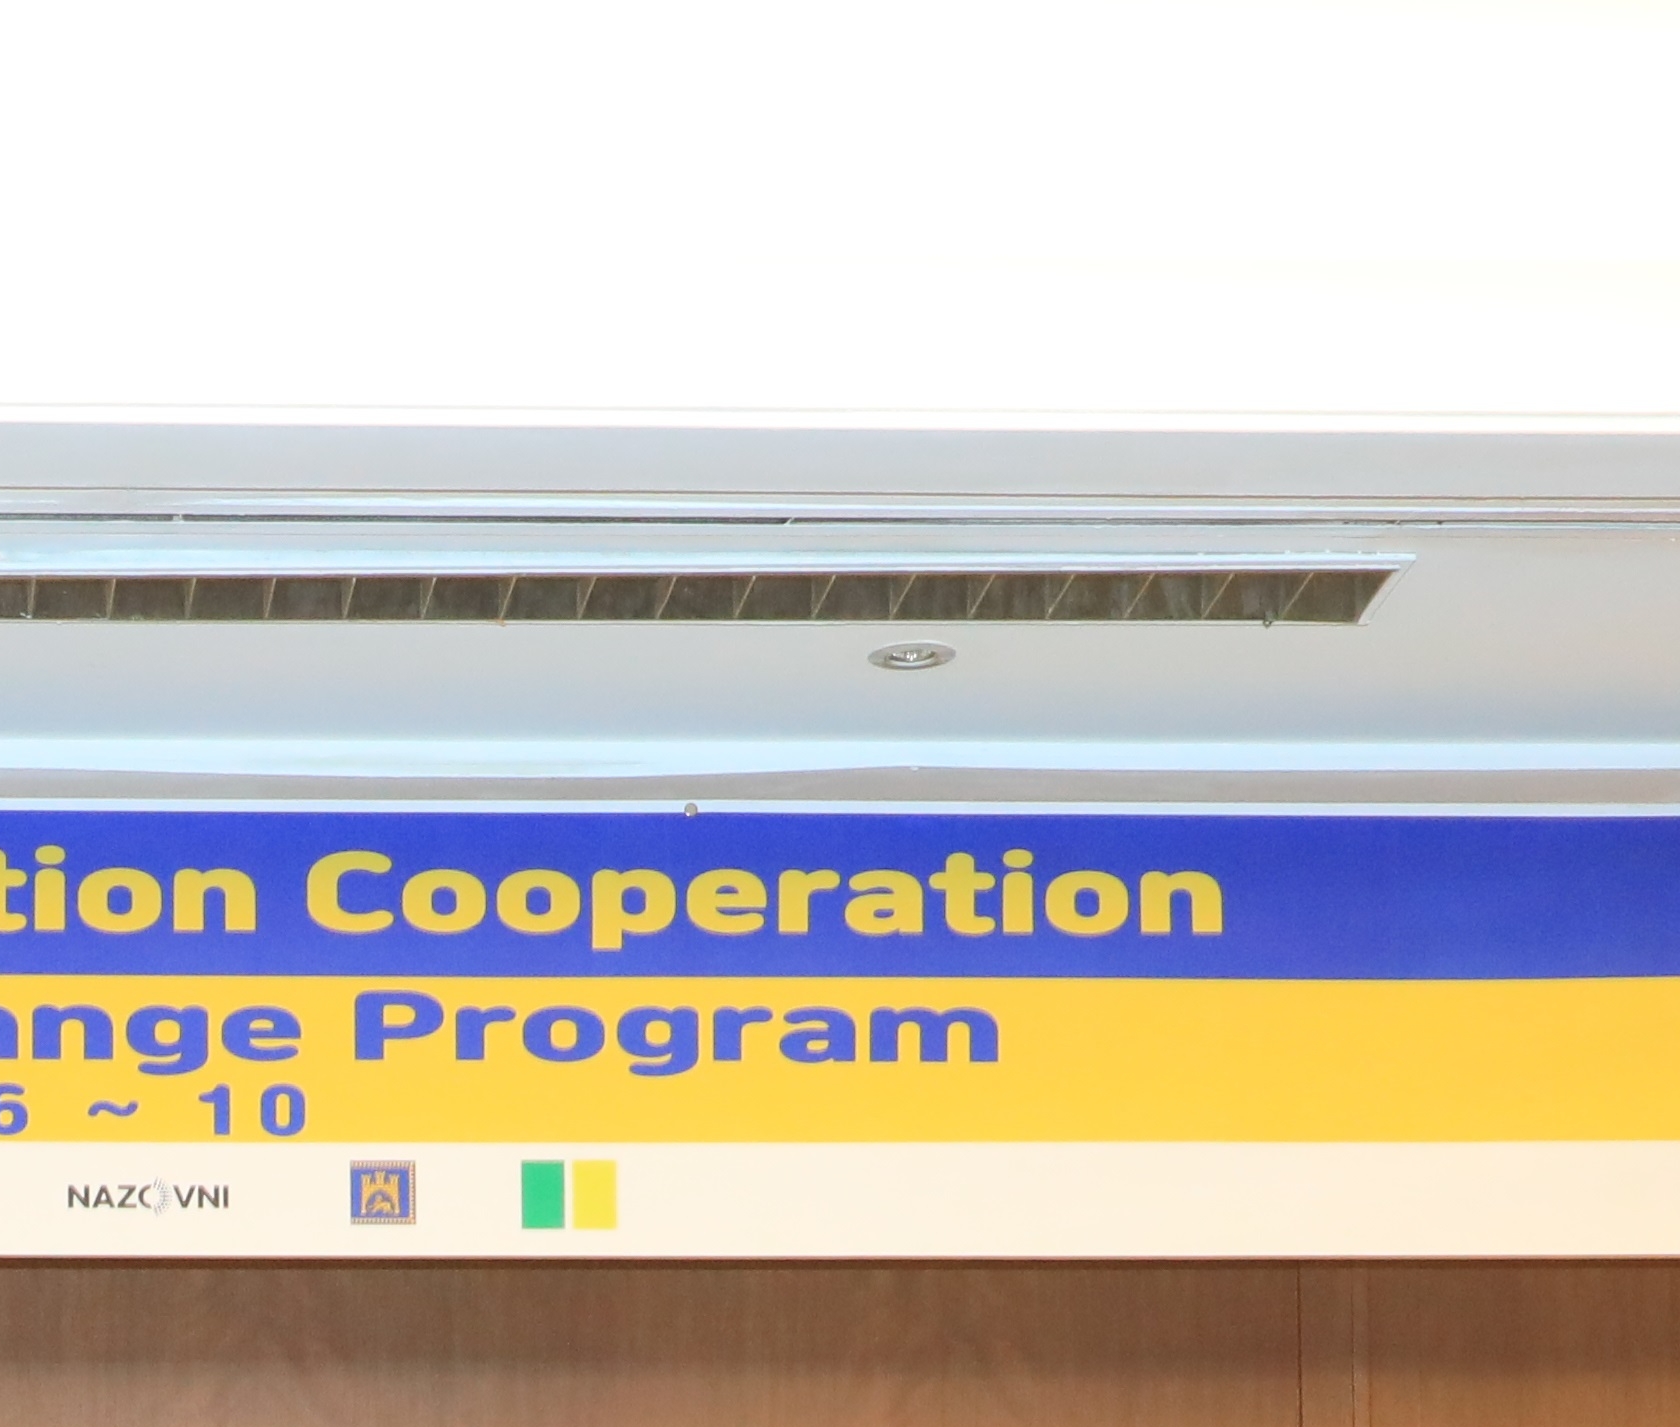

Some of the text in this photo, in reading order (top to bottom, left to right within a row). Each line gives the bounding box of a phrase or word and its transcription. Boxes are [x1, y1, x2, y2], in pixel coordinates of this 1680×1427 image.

[307, 849, 1224, 950] Cooperation
[356, 991, 998, 1076] Program
[198, 1085, 306, 1136] 10
